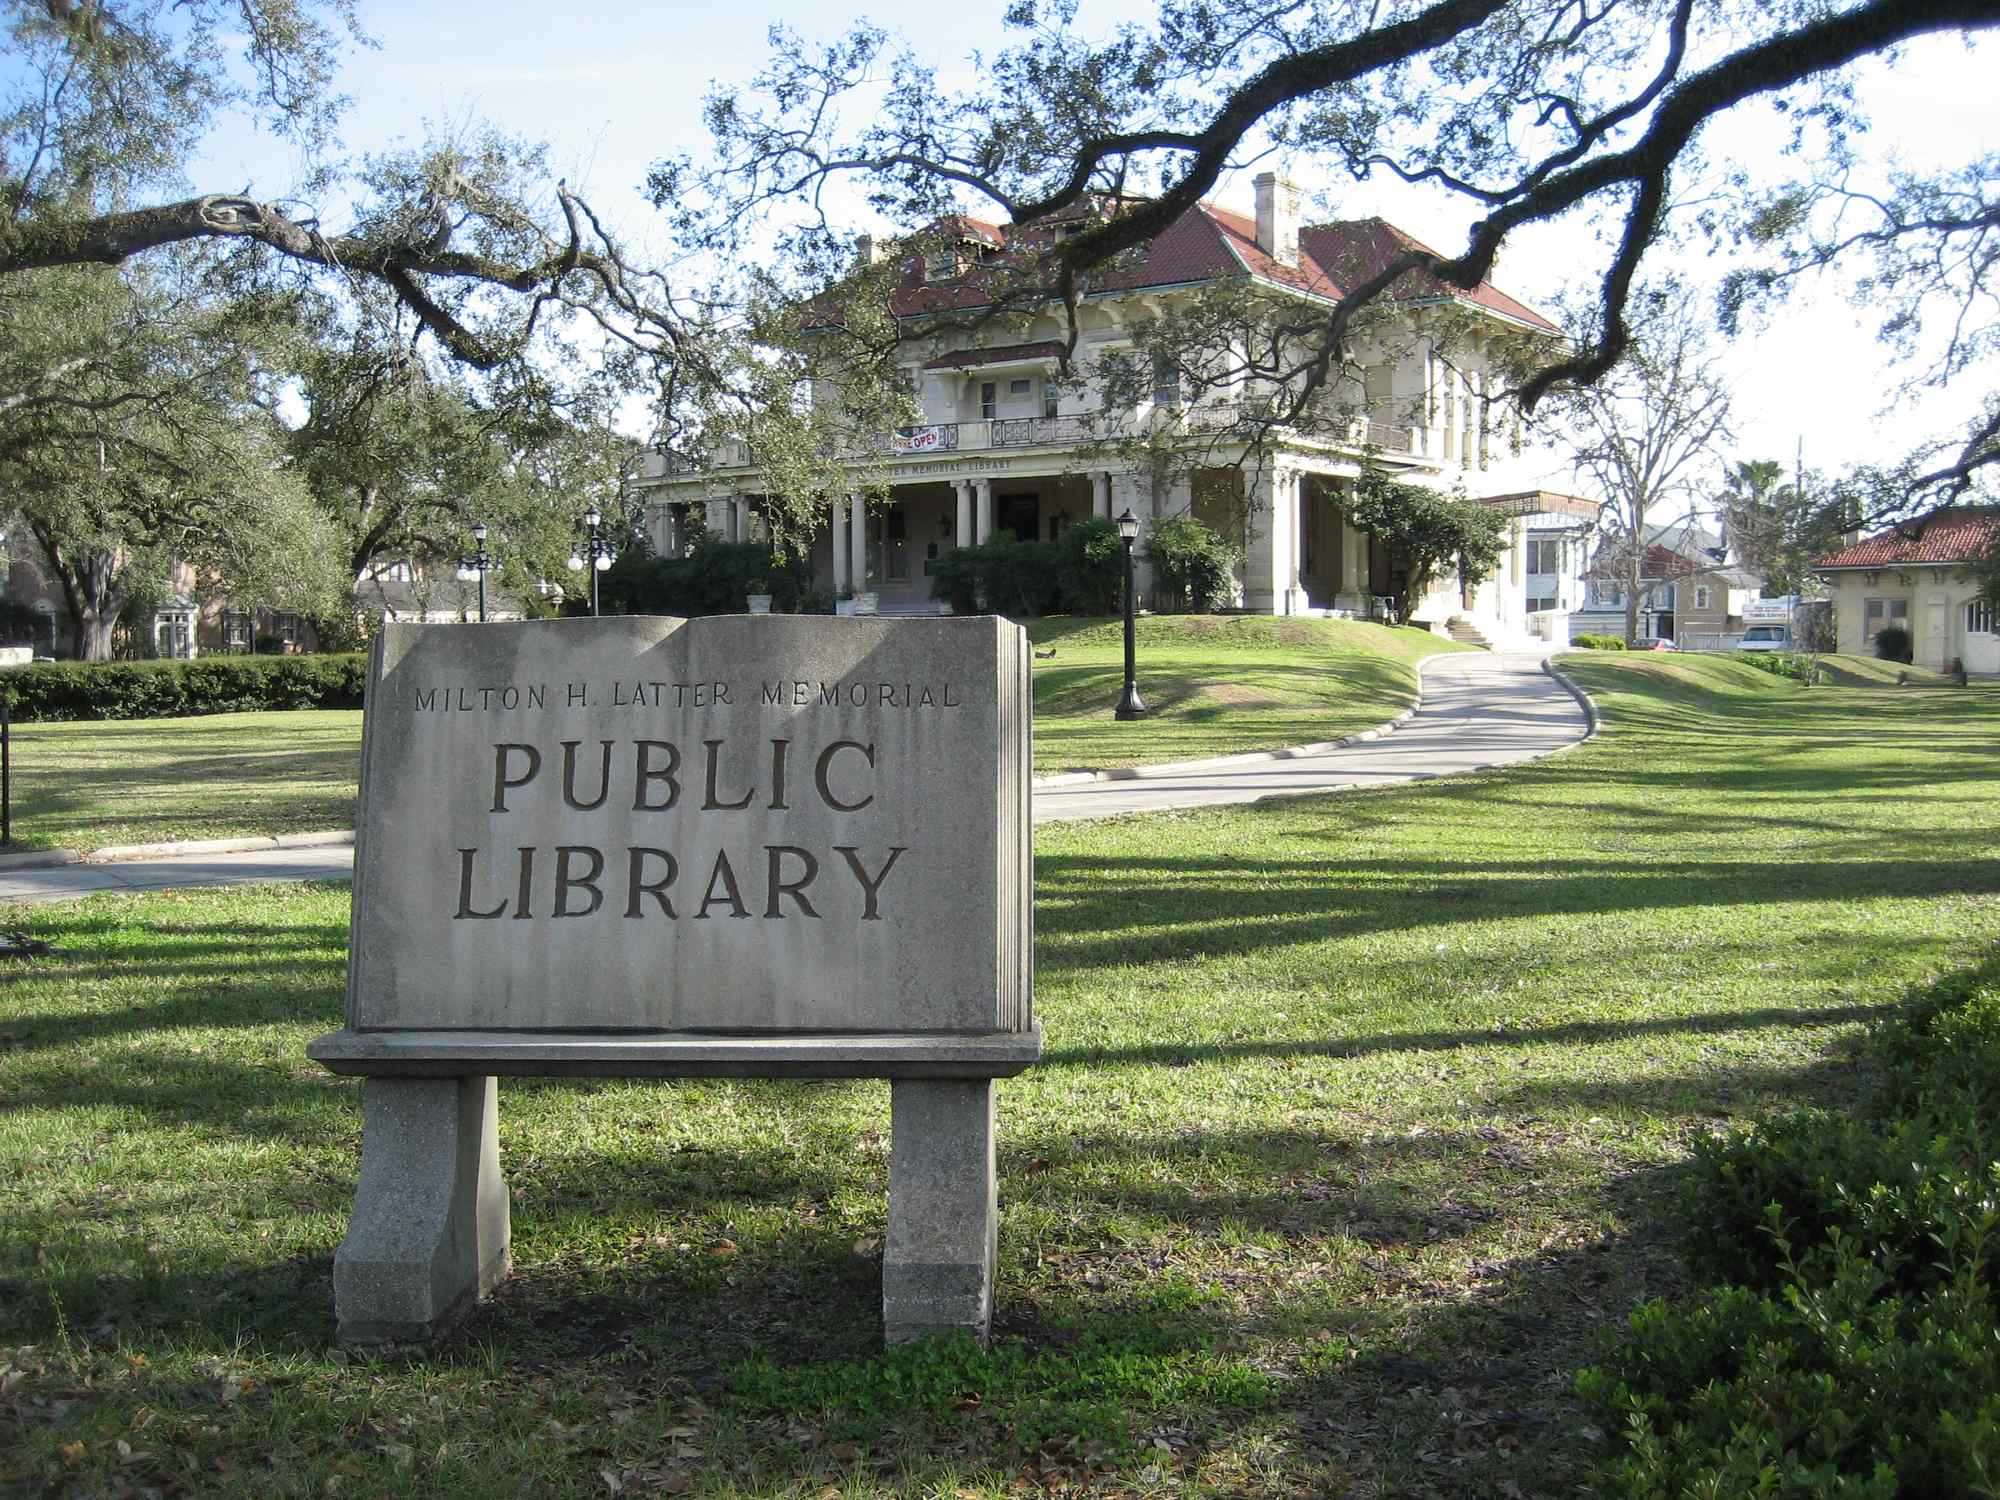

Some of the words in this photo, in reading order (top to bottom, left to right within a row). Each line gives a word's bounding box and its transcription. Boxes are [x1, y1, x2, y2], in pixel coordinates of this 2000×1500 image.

[913, 431, 938, 448] OPEN
[911, 463, 962, 475] MEMORIAL
[967, 460, 1010, 472] LIBRARY
[415, 685, 546, 712] MILTON
[567, 682, 598, 708] H.
[613, 681, 733, 707] LATTER
[761, 681, 961, 708] MEMORIAL
[489, 739, 876, 813] PUBLIC
[453, 845, 907, 921] LIBRARY
